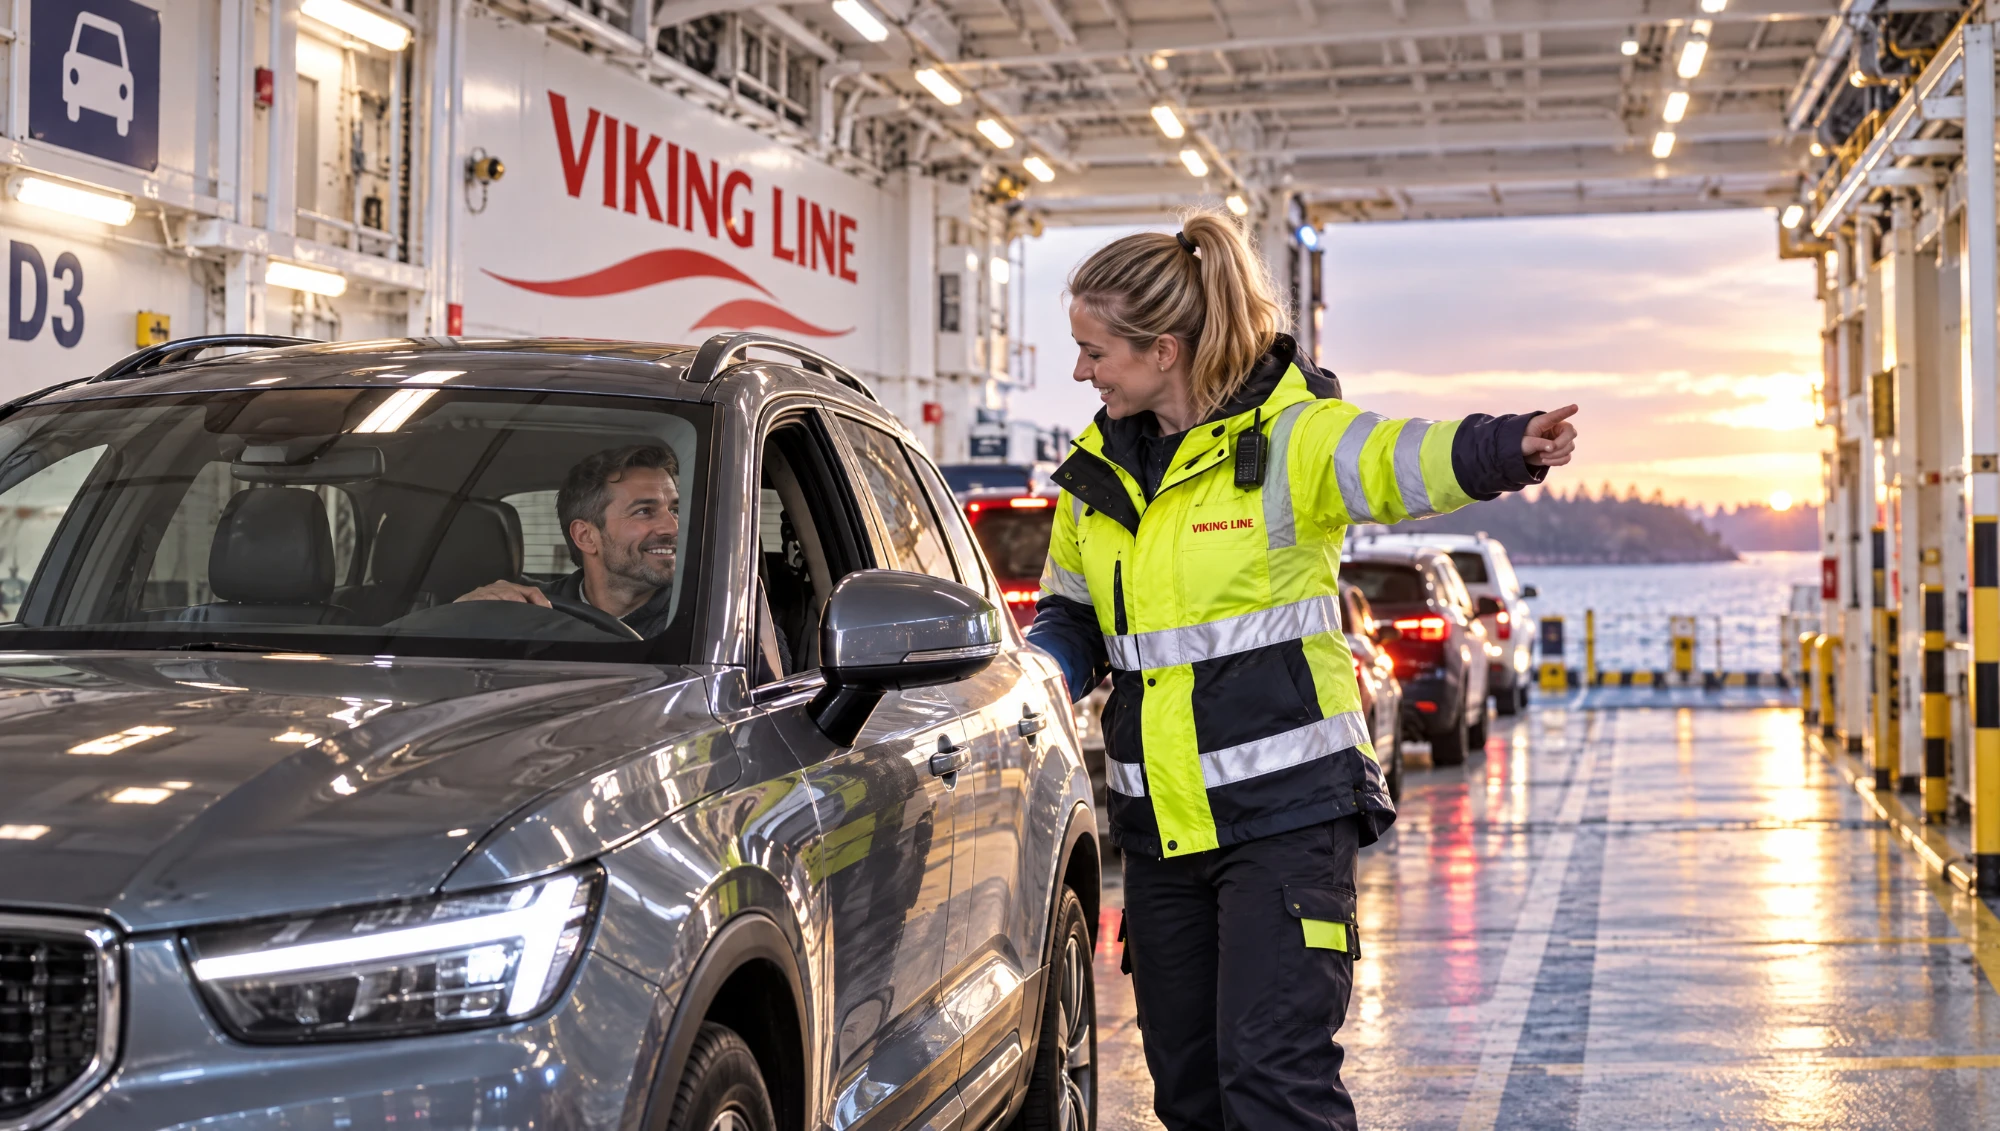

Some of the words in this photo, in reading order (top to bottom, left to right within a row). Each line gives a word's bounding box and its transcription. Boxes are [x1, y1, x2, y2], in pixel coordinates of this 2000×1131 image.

[547, 89, 754, 248] VIKING
[772, 185, 858, 284] LINE
[8, 239, 85, 349] D3
[1192, 521, 1228, 533] VIKING
[1231, 518, 1254, 529] LINE
